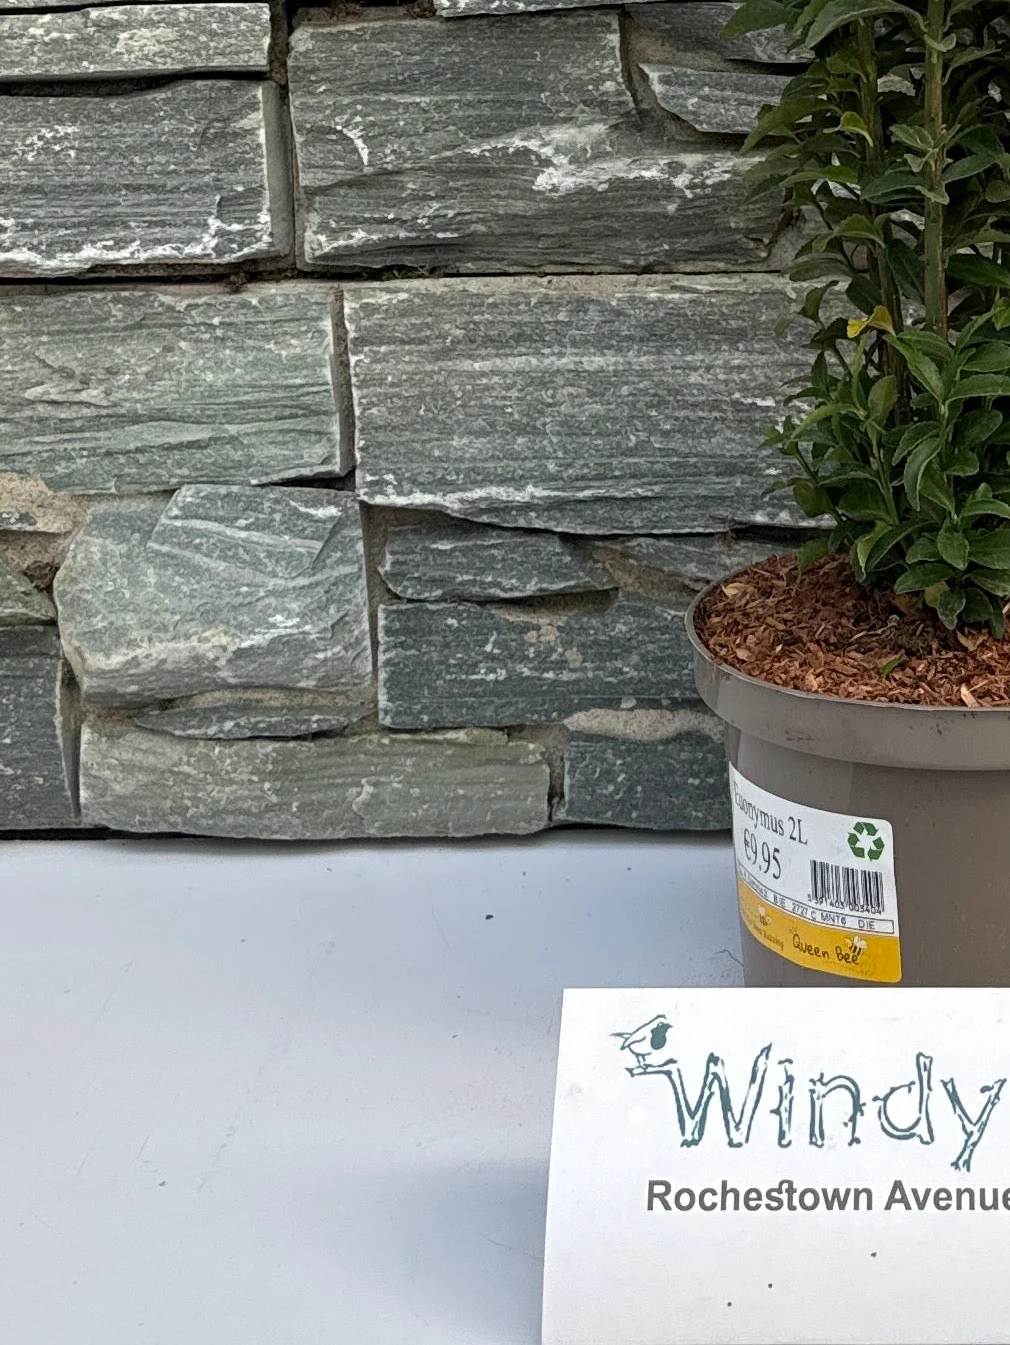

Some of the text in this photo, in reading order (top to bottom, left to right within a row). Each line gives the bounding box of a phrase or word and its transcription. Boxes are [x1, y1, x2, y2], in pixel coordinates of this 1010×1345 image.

[733, 781, 808, 845] Euonymus 2L
[743, 827, 782, 880] €9.95
[792, 933, 860, 965] Queen Bee
[646, 1178, 873, 1212] Rochestown
